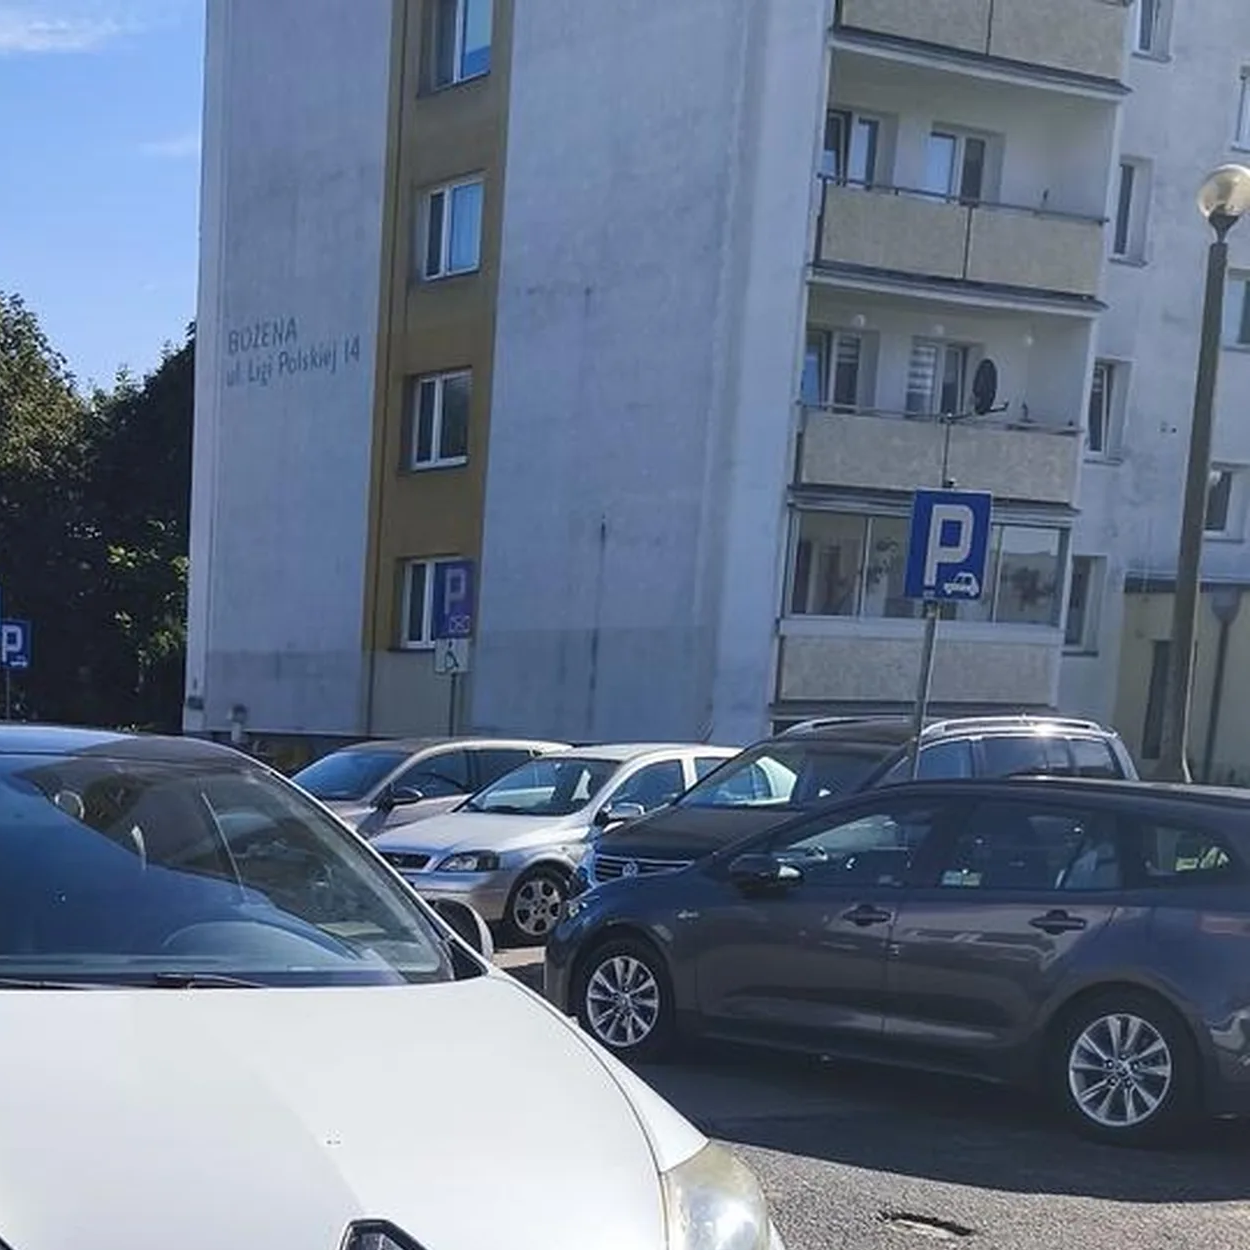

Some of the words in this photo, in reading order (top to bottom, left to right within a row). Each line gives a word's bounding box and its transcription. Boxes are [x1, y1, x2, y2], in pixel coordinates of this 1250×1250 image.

[345, 334, 361, 363] 14
[924, 504, 975, 586] P
[445, 568, 467, 615] P
[1, 624, 23, 663] P
